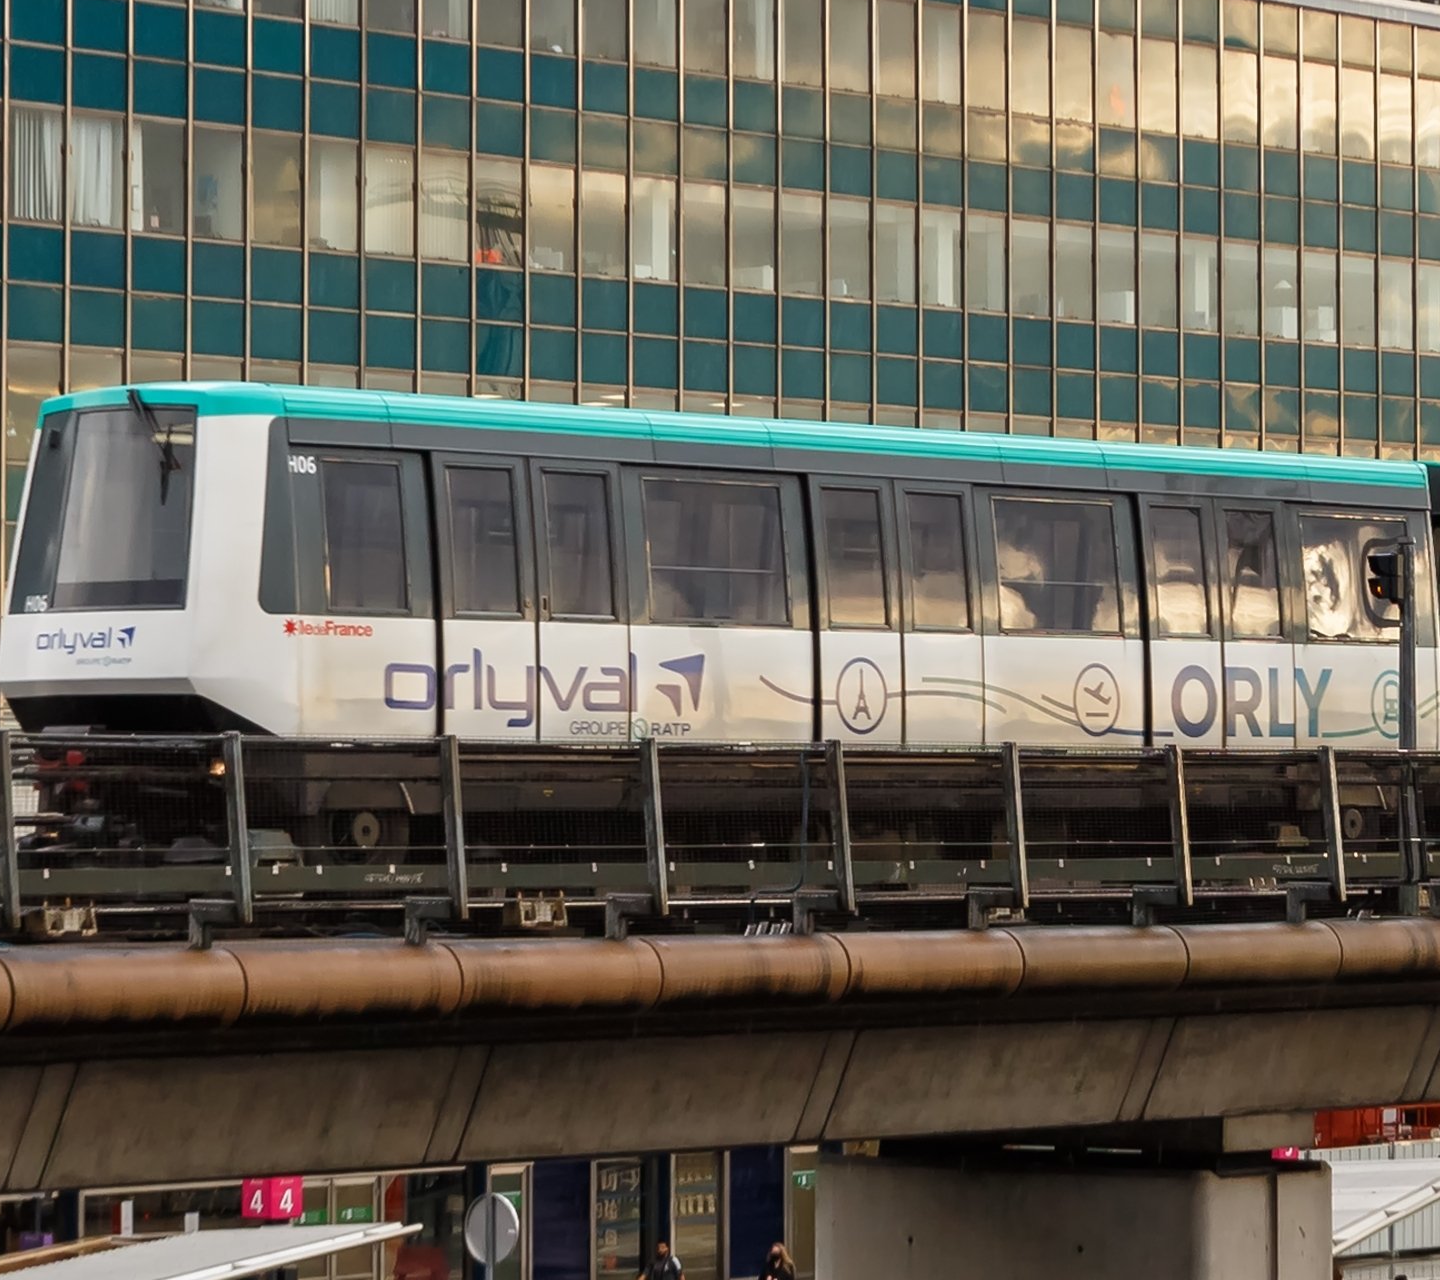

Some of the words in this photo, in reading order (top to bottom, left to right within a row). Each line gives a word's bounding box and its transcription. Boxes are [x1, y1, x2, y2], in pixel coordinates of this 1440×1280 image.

[288, 455, 317, 474] H06
[24, 594, 49, 612] H06
[36, 626, 112, 654] orlyval
[384, 647, 638, 728] orlyval
[1171, 664, 1333, 739] ORLY
[569, 720, 627, 736] GROUPE
[650, 722, 691, 737] RATP
[250, 1189, 264, 1214] 4
[279, 1188, 294, 1214] 4
